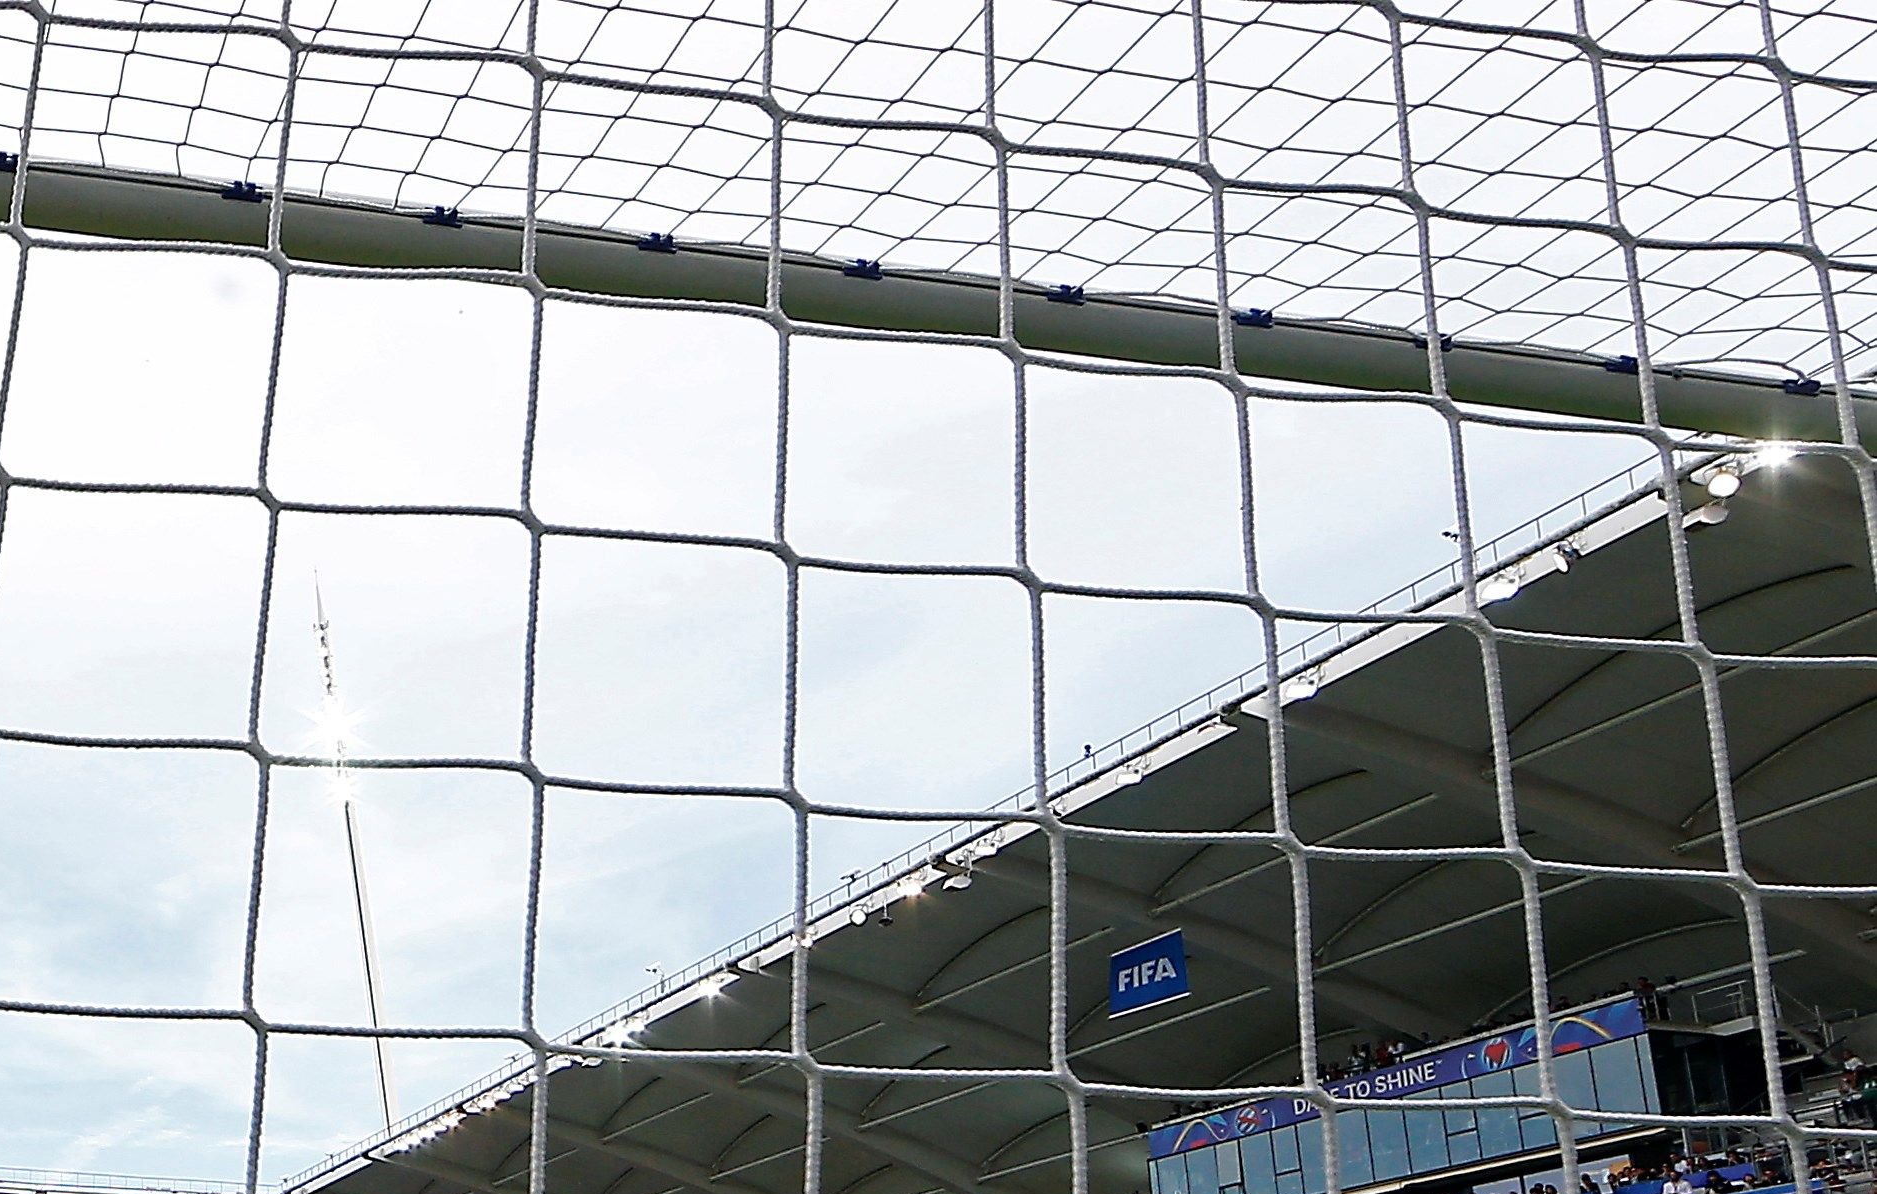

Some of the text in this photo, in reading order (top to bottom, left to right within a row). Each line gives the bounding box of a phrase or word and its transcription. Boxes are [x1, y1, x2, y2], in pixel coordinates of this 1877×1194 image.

[1118, 957, 1177, 992] FIFA
[1344, 1080, 1370, 1099] TO
[1375, 1062, 1436, 1093] SHINE
